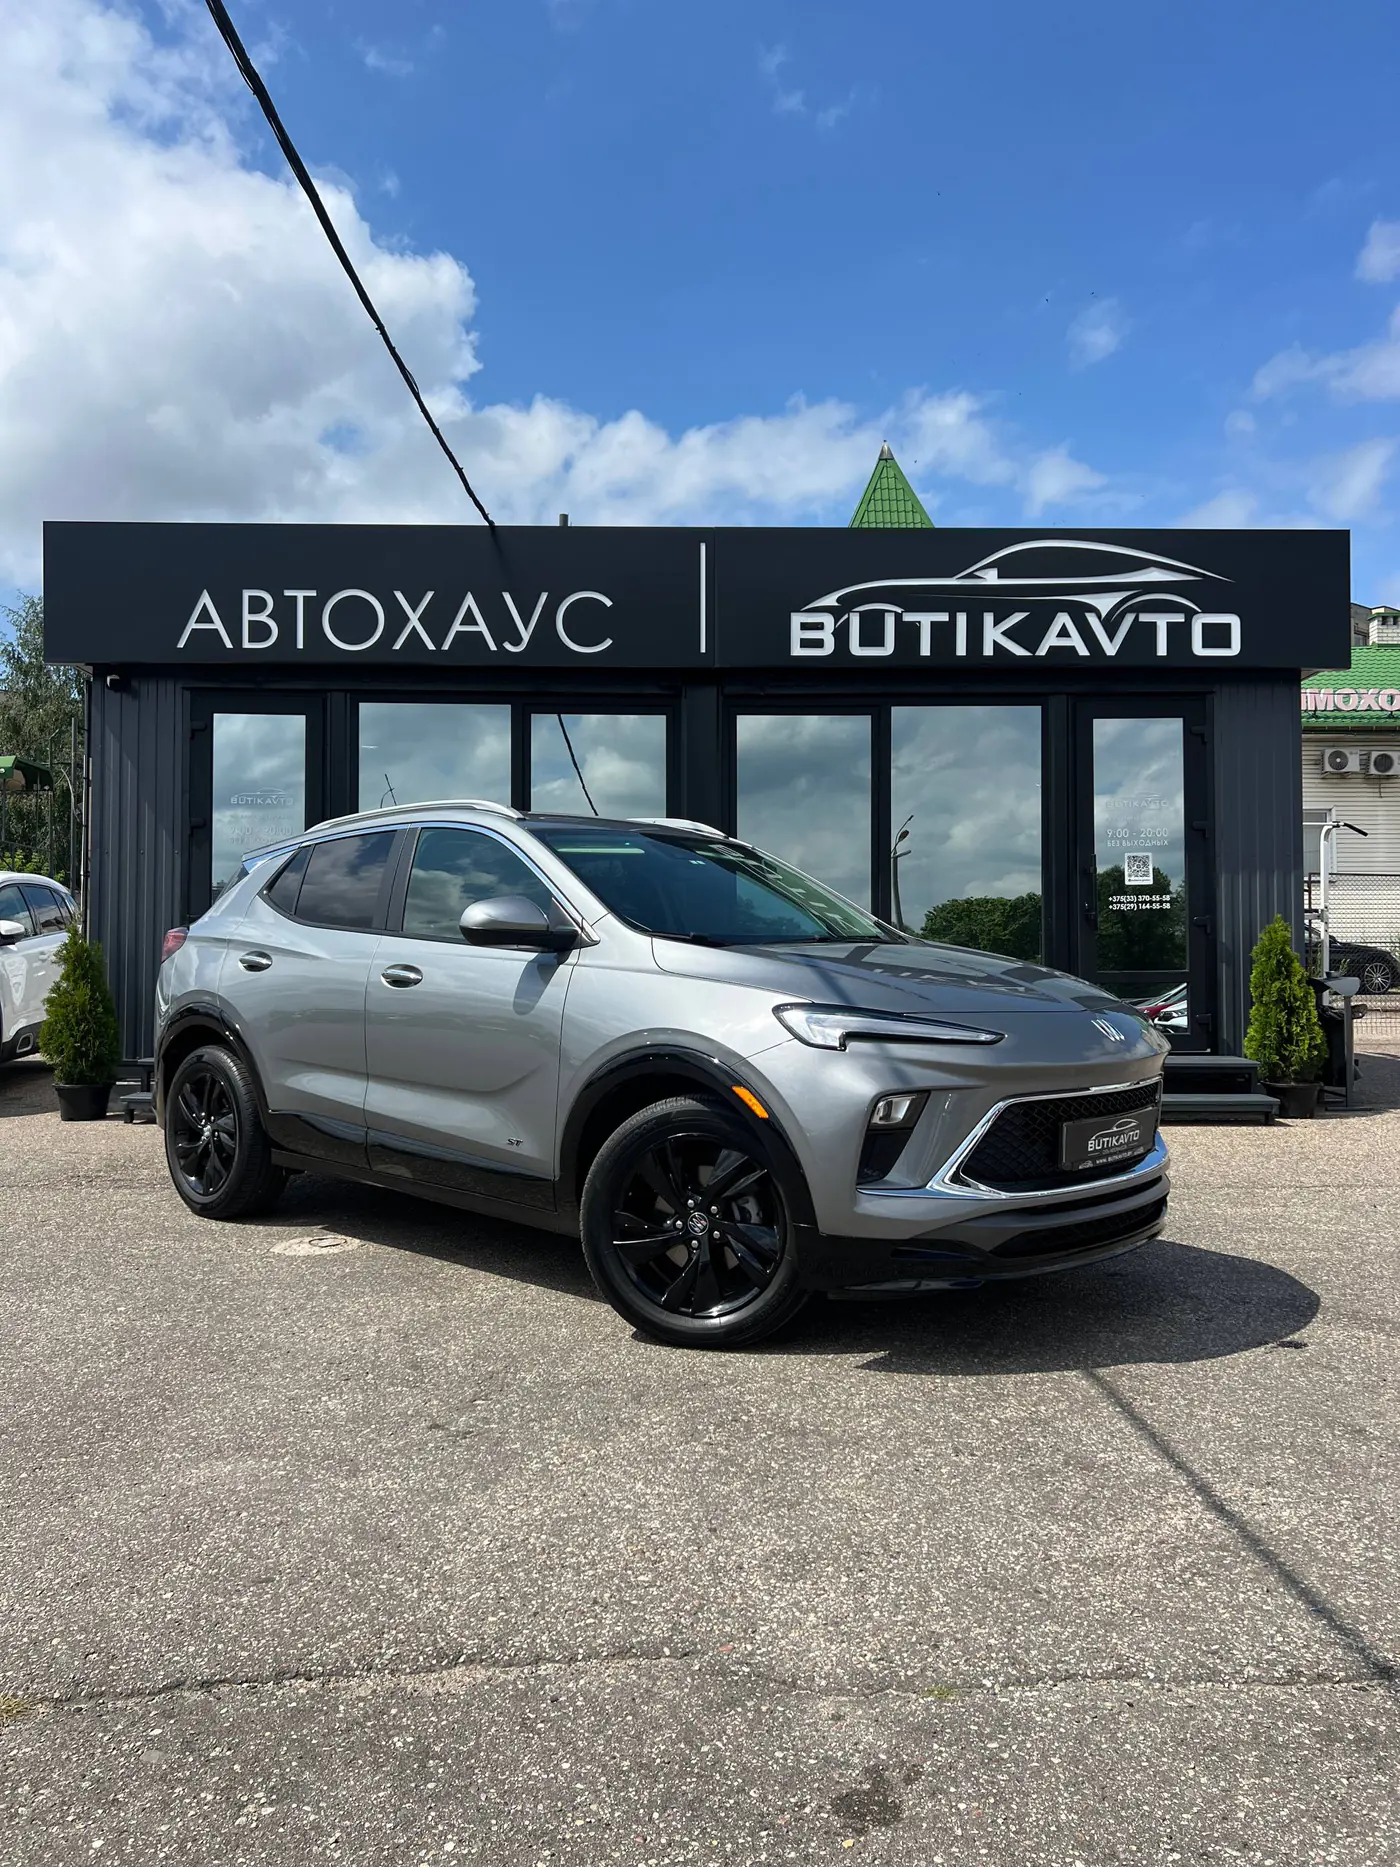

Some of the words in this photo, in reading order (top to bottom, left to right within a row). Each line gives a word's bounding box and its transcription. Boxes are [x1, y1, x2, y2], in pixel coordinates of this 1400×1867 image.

[176, 588, 614, 654] АВТОХАУС
[790, 611, 1242, 657] BUTIKAVTO
[1301, 687, 1400, 712] МОХО
[1106, 828, 1130, 838] 9:00
[1139, 827, 1169, 838] 20:00
[1107, 839, 1120, 847] БЕЗ
[1122, 839, 1169, 847] ВЫХОДНЫХ
[1109, 894, 1137, 903] +375(33)
[1138, 894, 1171, 902] 370-55-58
[1109, 902, 1137, 911] +375(29)
[1138, 902, 1171, 910] 164-55-58
[1087, 1129, 1140, 1152] BUTIKAVTO
